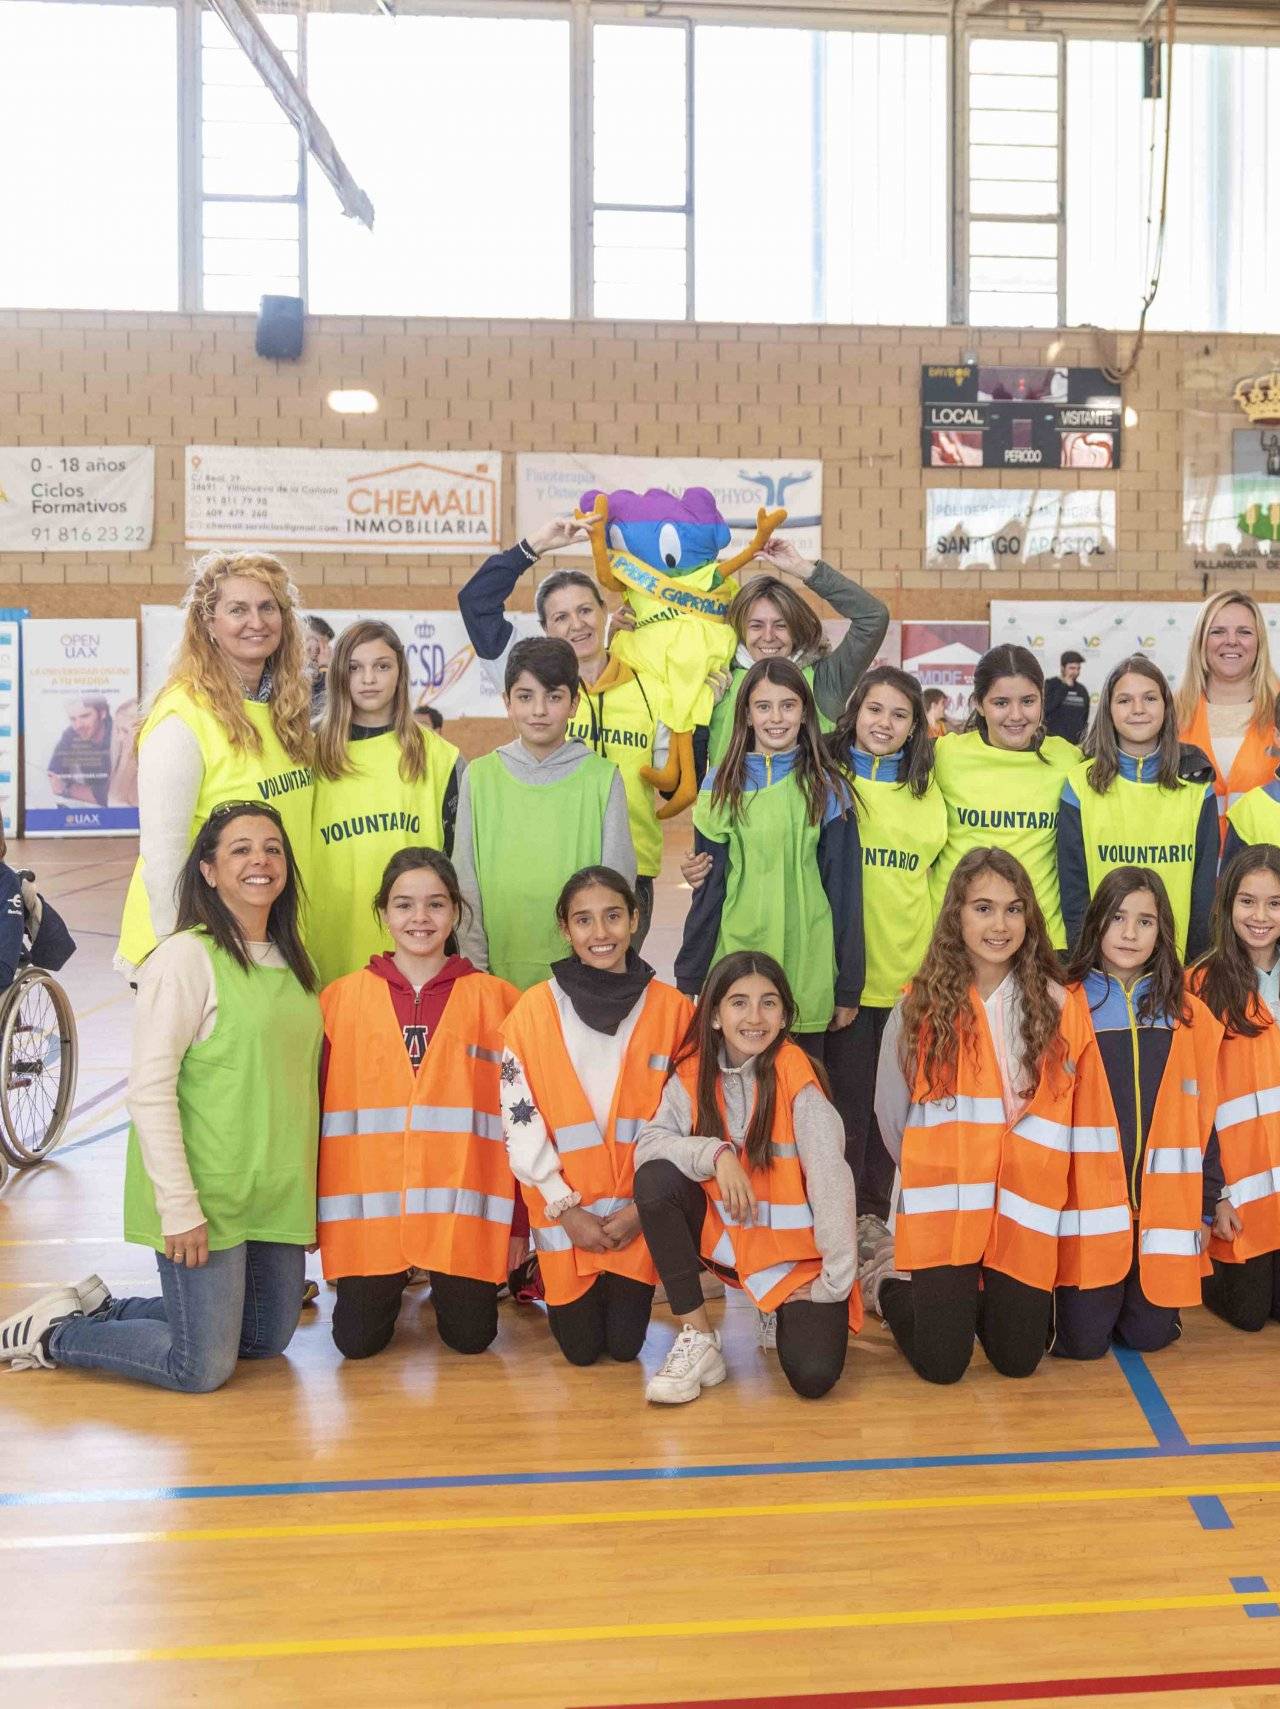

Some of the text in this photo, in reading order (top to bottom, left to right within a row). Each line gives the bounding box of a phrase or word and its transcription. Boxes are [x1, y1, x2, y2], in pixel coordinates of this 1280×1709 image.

[931, 408, 1113, 425] LOCAL VISITANTE
[1004, 449, 1042, 463] PERIODO
[31, 457, 41, 473] 0
[59, 457, 80, 473] 18
[85, 456, 127, 473] años
[31, 482, 85, 498] Ciclos
[31, 498, 128, 514] Formativos
[31, 525, 146, 542] 91 816 23 22
[346, 518, 489, 535] INMOBILIARIA
[1194, 559, 1258, 570] VILLANUEVA
[1265, 560, 1280, 570] DE
[60, 633, 100, 647] OPEN
[65, 647, 98, 659] UAX
[405, 643, 446, 687] CSD
[73, 814, 101, 825] UAX
[320, 811, 421, 846] VOLUNTARIO
[861, 846, 919, 872] NTARIO
